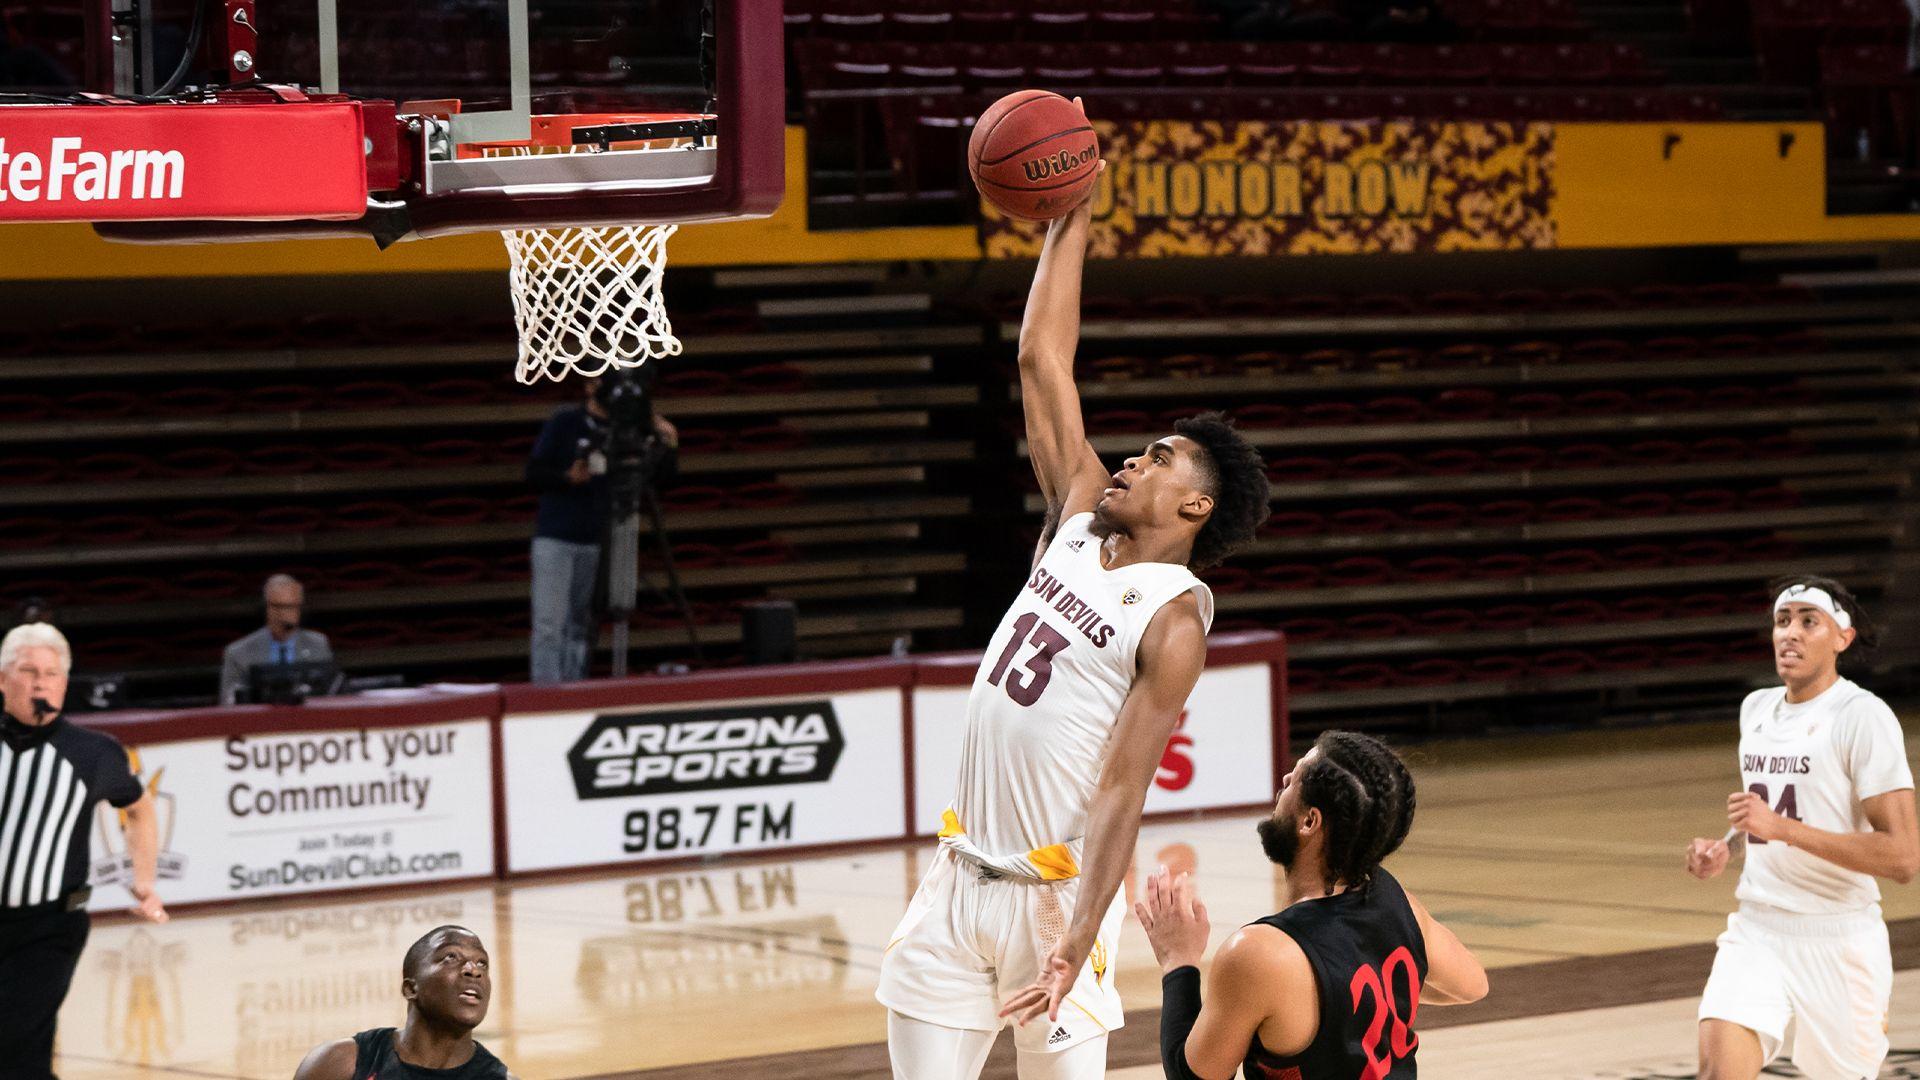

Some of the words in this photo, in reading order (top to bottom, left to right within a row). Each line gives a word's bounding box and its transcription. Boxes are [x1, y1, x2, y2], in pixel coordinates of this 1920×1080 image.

[47, 136, 186, 202] Farm
[1021, 143, 1098, 182] Wilson
[1134, 159, 1302, 218] HONOR
[1323, 159, 1431, 217] ROW
[1053, 590, 1116, 649] DEVILS
[987, 612, 1071, 708] 13
[226, 730, 371, 776] Support
[383, 729, 457, 767] your
[582, 713, 831, 760] ARIZONA
[593, 745, 819, 789] SPORTS
[1744, 753, 1767, 773] SUN
[1769, 755, 1810, 774] DEVILS
[228, 772, 431, 817] Community
[622, 804, 721, 853] 98.7
[733, 801, 795, 843] FM
[229, 851, 462, 890] SunDevilClub.com
[1349, 946, 1421, 1080] 20
